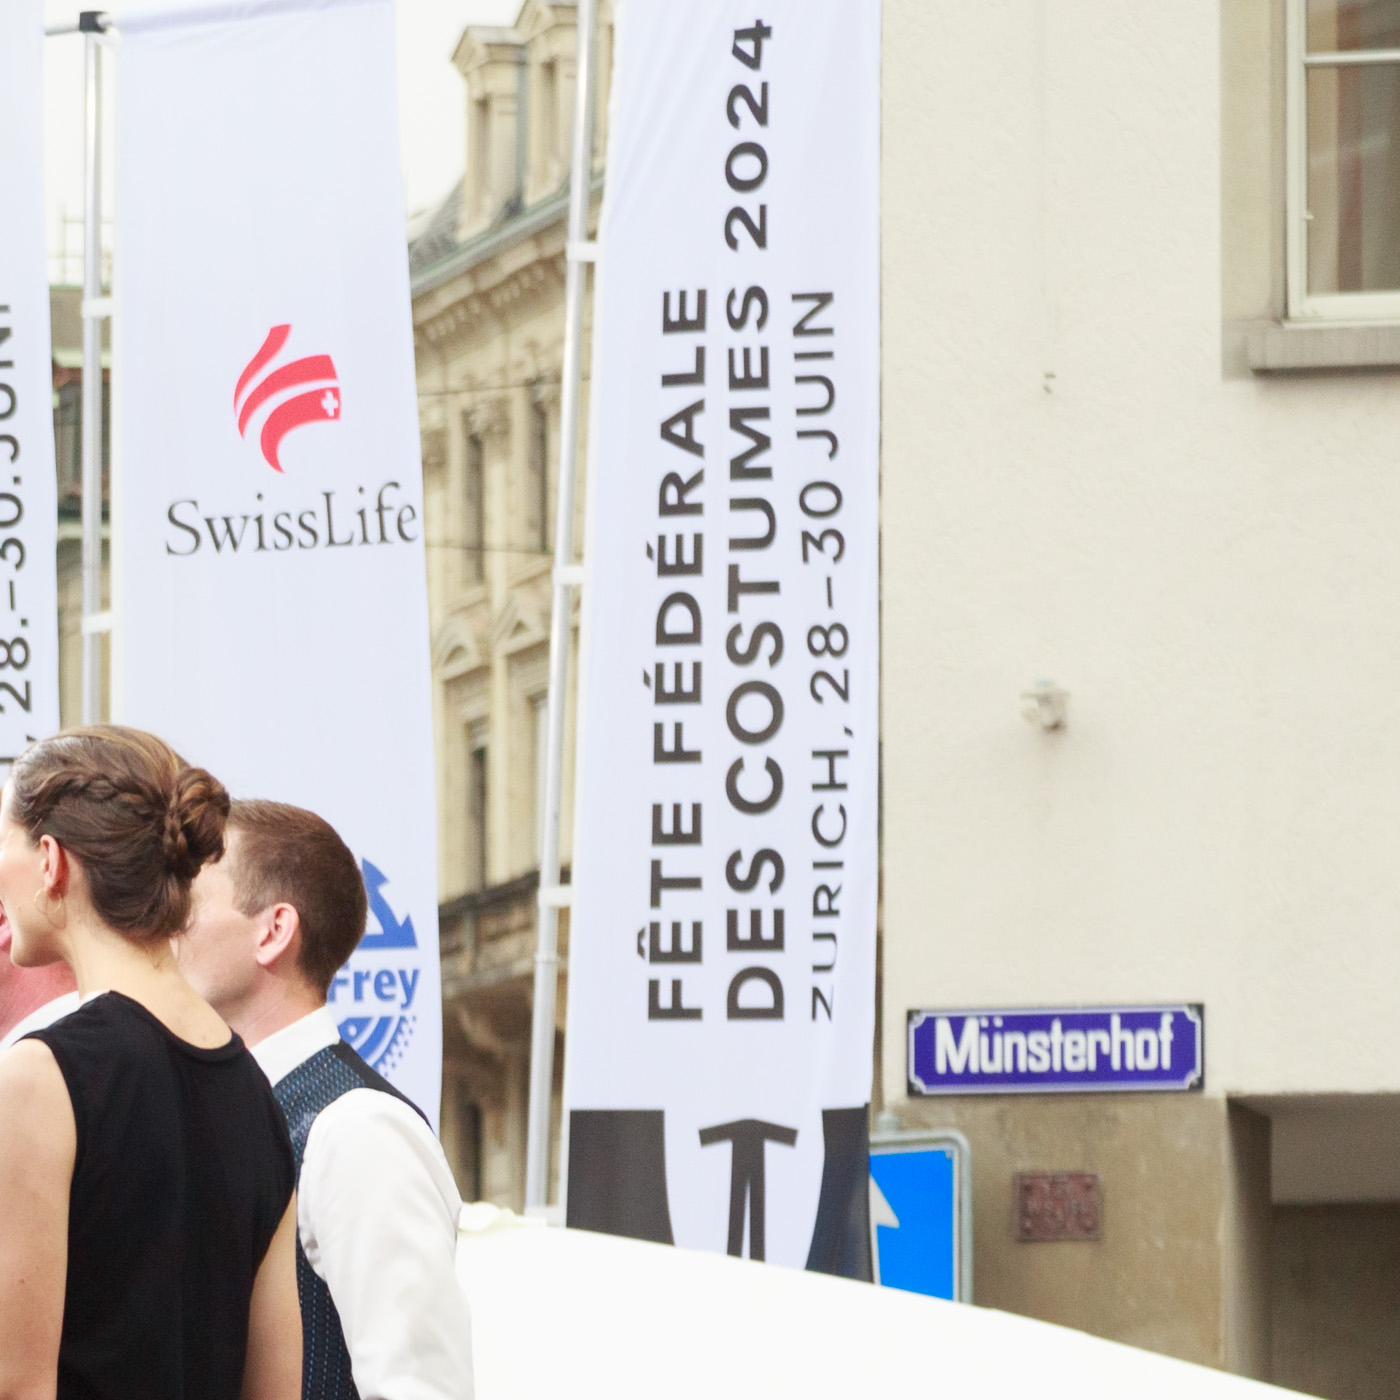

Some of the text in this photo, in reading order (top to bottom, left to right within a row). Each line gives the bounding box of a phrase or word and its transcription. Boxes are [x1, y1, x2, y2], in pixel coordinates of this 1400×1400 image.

[724, 19, 785, 1022] DES COSTUMES 2024
[791, 291, 839, 461] JUIN
[637, 288, 707, 1022] FÊTE FÉDÉRALE
[935, 1011, 1174, 1075] Münsterhof
